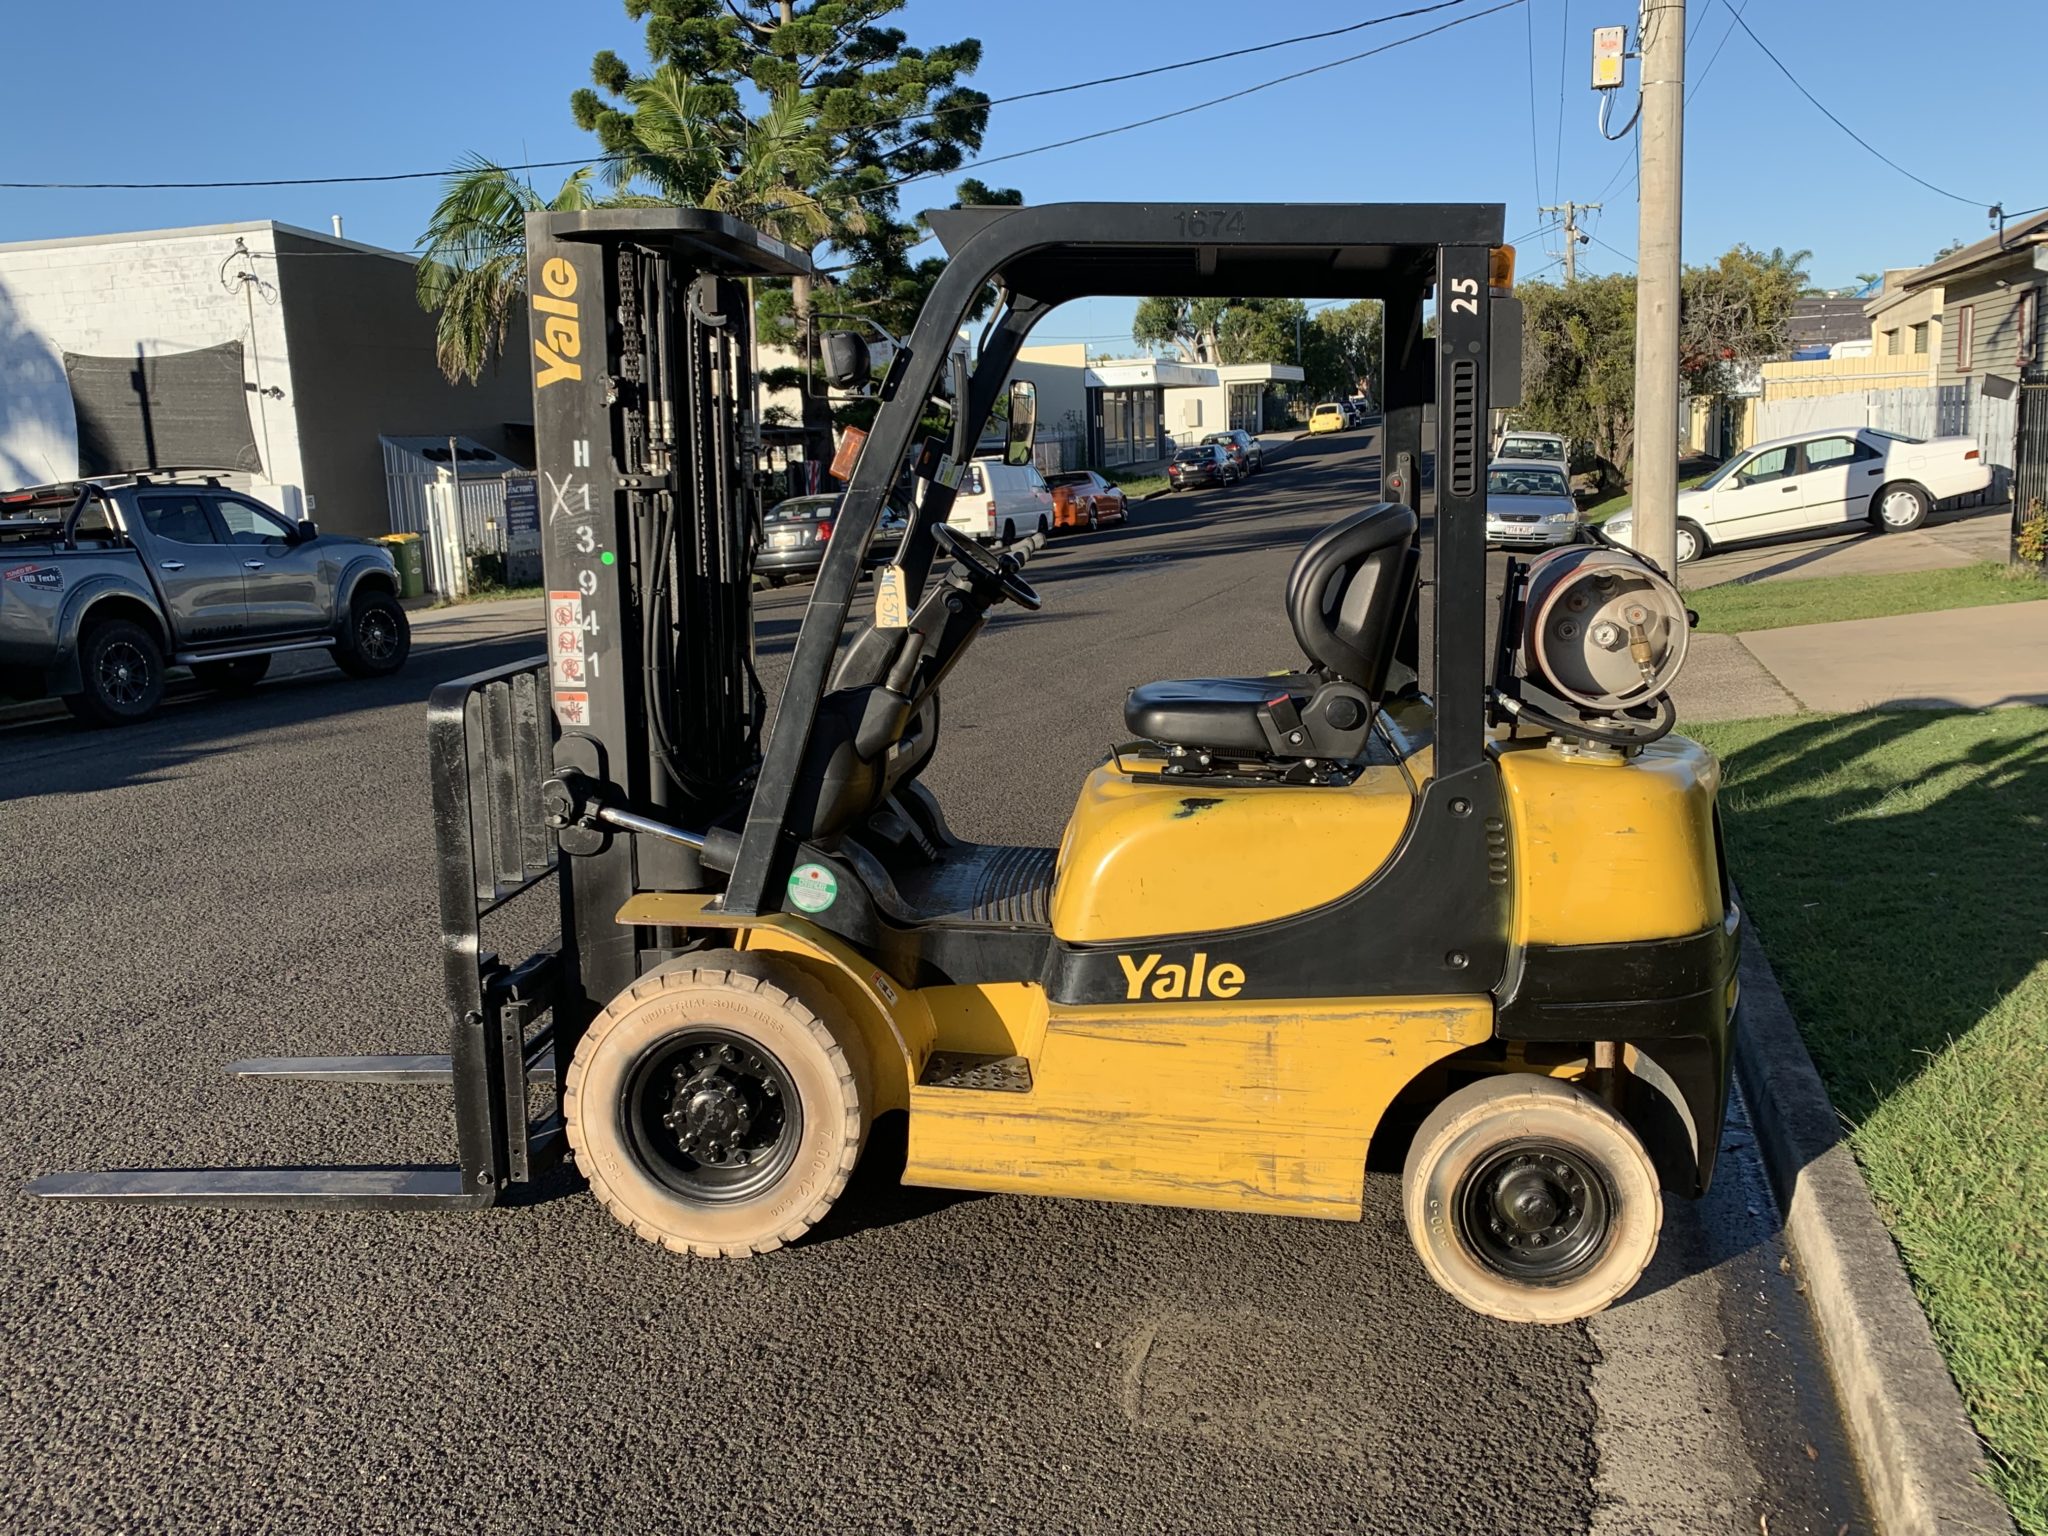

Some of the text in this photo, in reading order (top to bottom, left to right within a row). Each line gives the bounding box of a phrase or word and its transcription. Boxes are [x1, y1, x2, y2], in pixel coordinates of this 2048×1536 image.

[1173, 210, 1246, 237] 1674
[1451, 278, 1479, 315] 25
[533, 257, 582, 389] Yale
[38, 574, 56, 582] Tech
[1117, 953, 1246, 1000] Yale
[641, 998, 785, 1033] INDUSTRIAL SOLID TIRES
